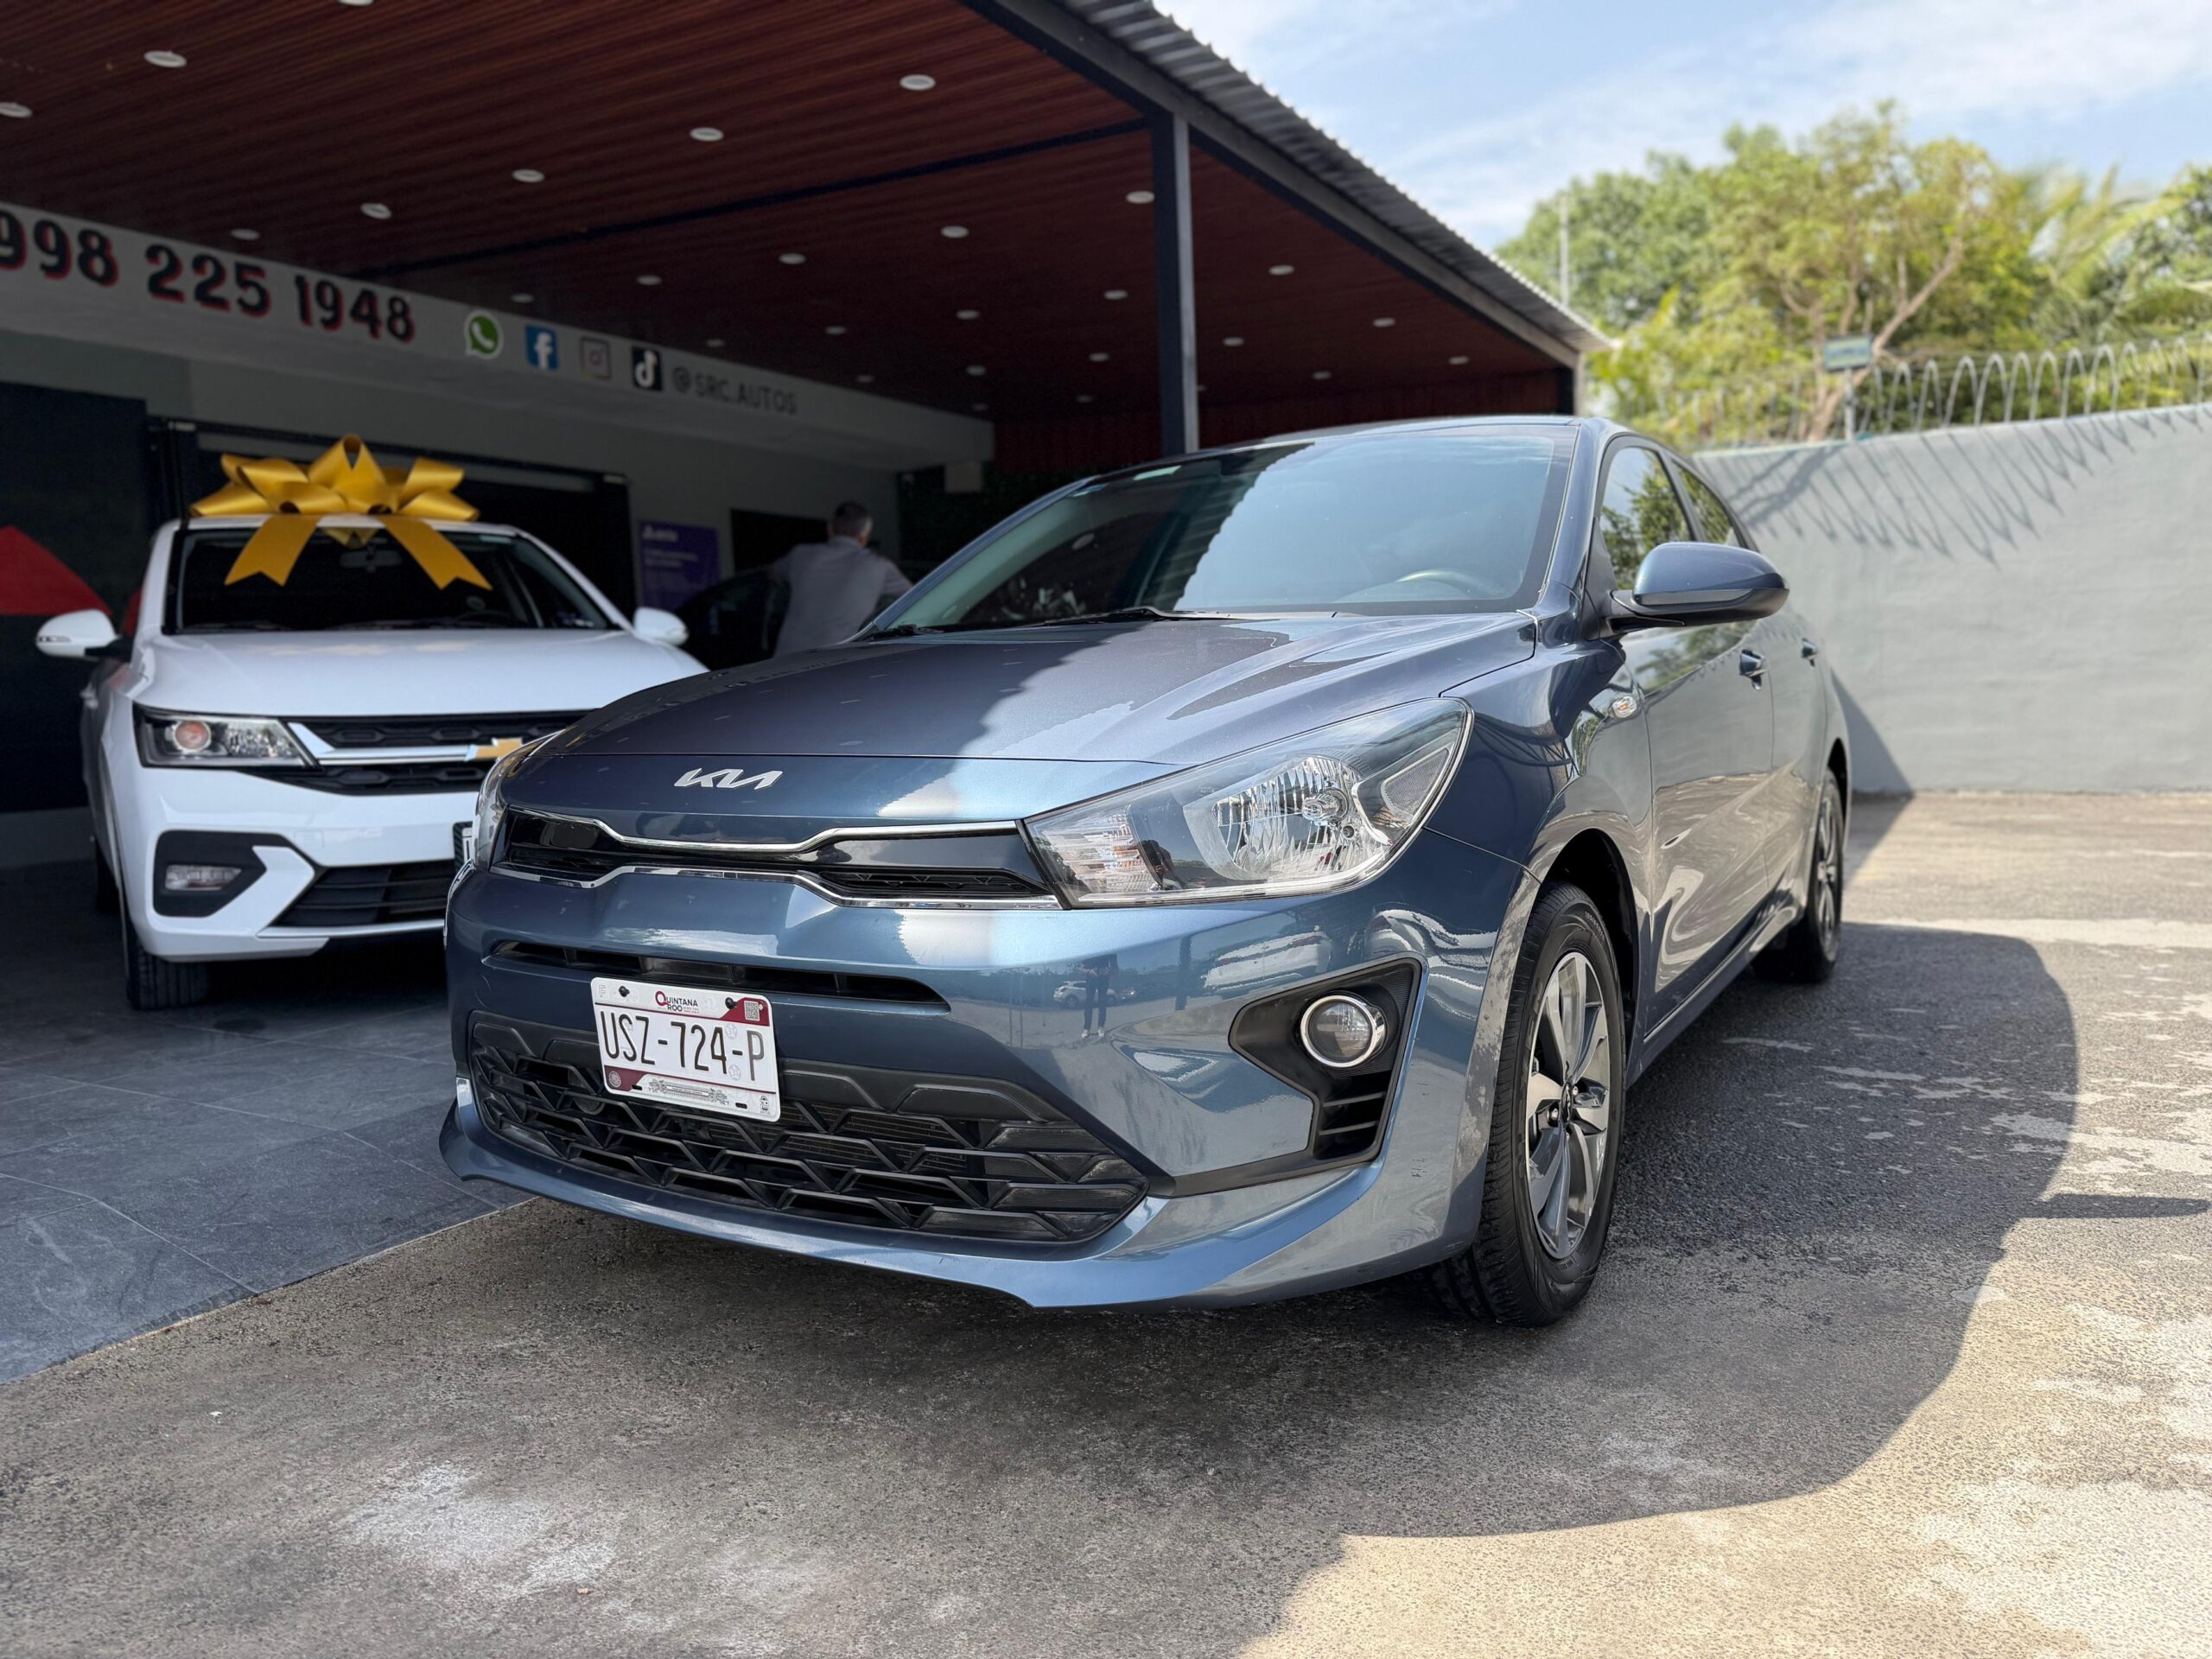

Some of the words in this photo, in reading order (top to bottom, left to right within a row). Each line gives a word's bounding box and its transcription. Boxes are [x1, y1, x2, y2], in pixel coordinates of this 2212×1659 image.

[0, 209, 118, 288] 998
[144, 244, 272, 318] 225
[295, 274, 415, 345] 1948
[673, 767, 784, 791] KIA
[655, 990, 699, 1007] QUINTANA
[666, 1003, 683, 1013] ROO
[600, 1010, 766, 1082] USZ-724-P
